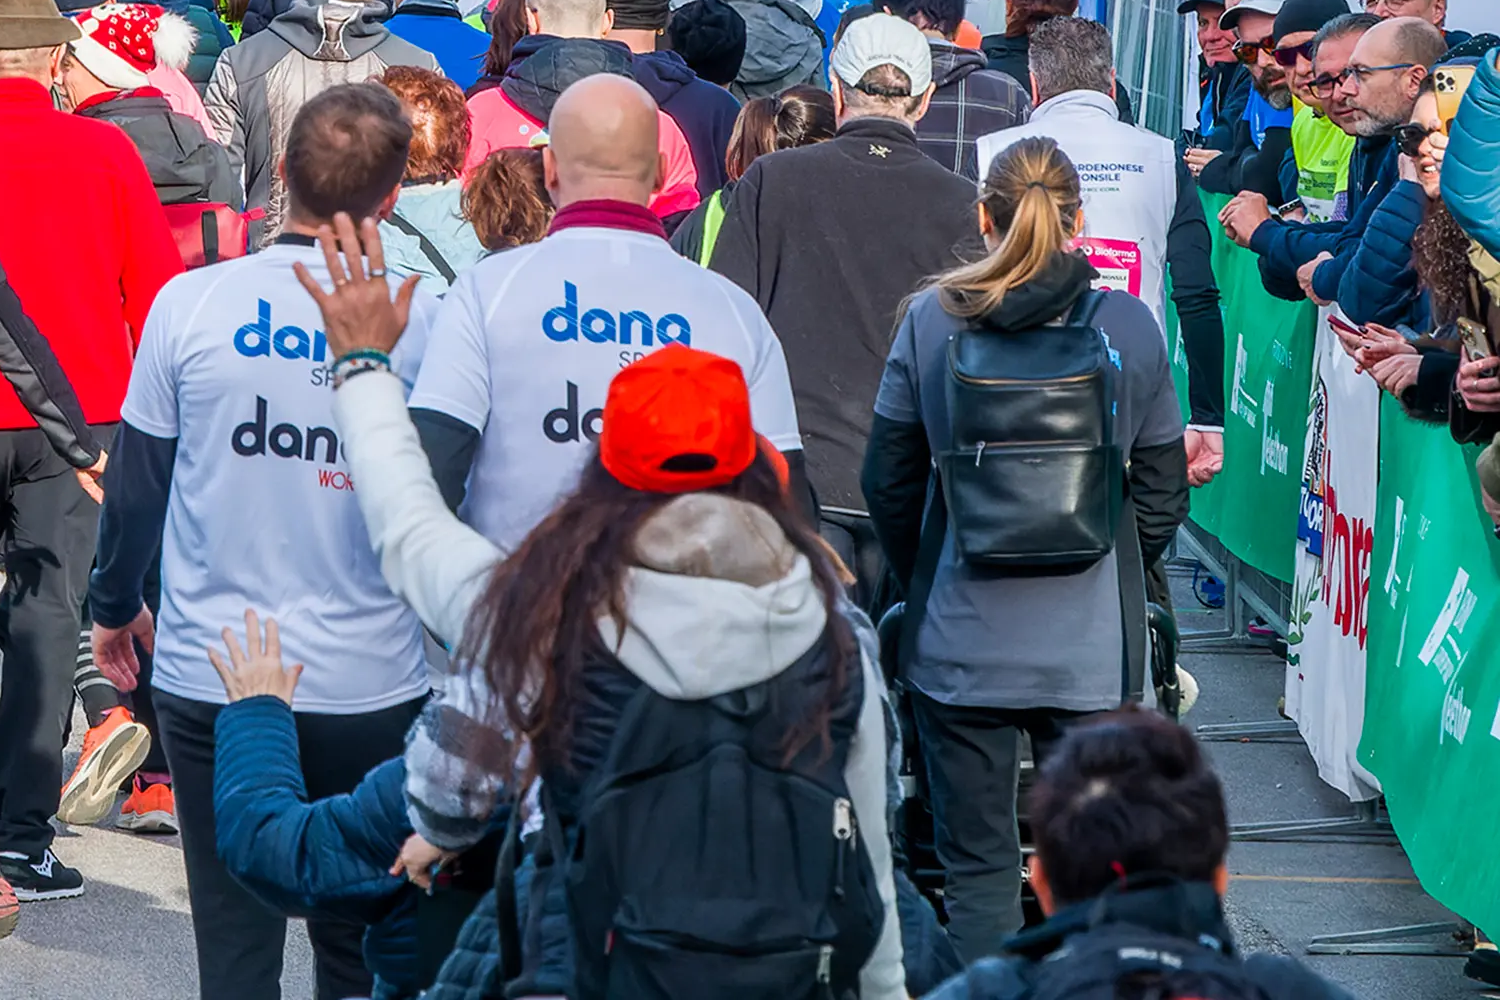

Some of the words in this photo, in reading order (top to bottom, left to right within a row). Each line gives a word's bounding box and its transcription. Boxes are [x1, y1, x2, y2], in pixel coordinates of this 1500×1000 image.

[1081, 172, 1121, 182] ONSILE
[233, 297, 328, 362] da
[542, 280, 691, 348] dana
[231, 394, 348, 465] dan
